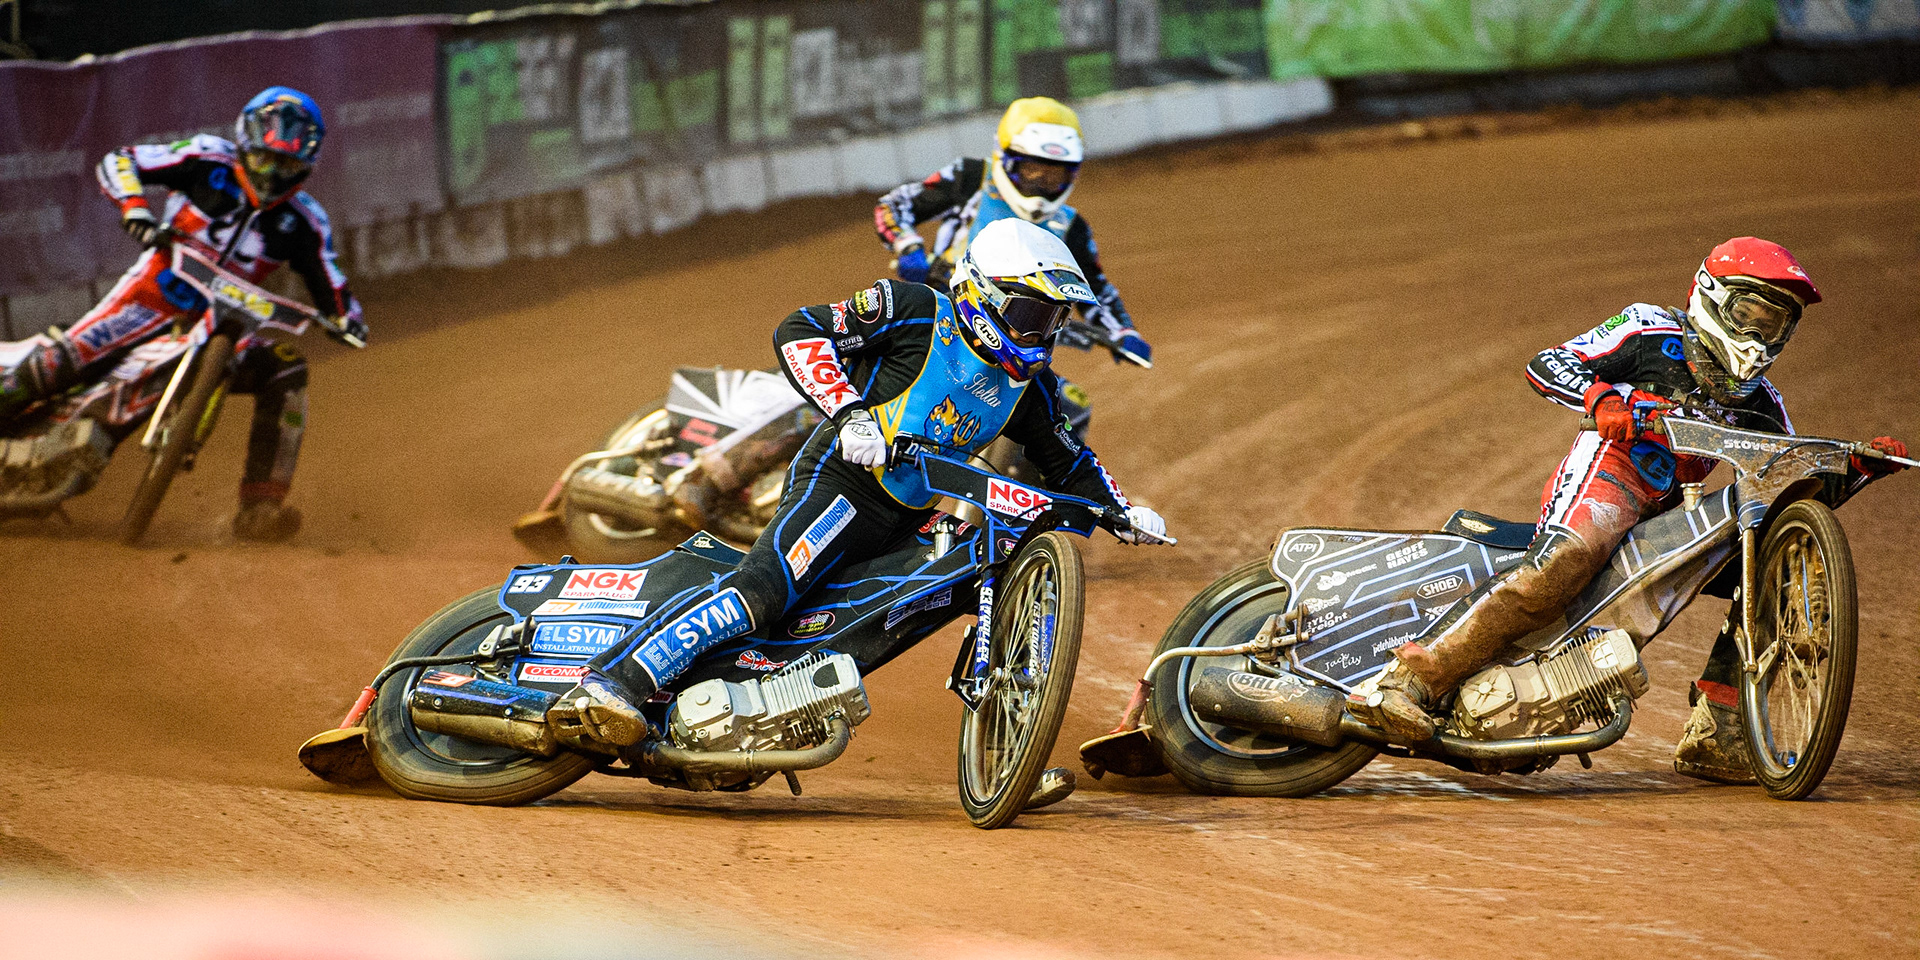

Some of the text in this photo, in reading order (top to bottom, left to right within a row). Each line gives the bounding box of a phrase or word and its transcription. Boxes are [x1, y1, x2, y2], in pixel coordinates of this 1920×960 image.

[1060, 285, 1092, 298] Arai
[976, 321, 997, 345] Arai
[785, 347, 833, 414] SPARK PLUGS
[796, 341, 860, 404] NGK
[963, 373, 1002, 408] Stellar
[990, 481, 1048, 512] NGK
[990, 501, 1019, 514] SPARK
[805, 498, 851, 546] EDMUNDSON
[1289, 543, 1317, 553] ATPI
[1385, 541, 1425, 562] GEOFF
[1386, 548, 1429, 569] HAYES
[508, 575, 550, 593] 93
[567, 572, 643, 591] NGK
[1422, 577, 1458, 597] SHOEI
[599, 591, 634, 599] PLUGS
[539, 626, 617, 646] ELSYM
[644, 598, 740, 672] ELSYM
[726, 623, 748, 637] LTD
[533, 643, 596, 653] INSTALLATIONS
